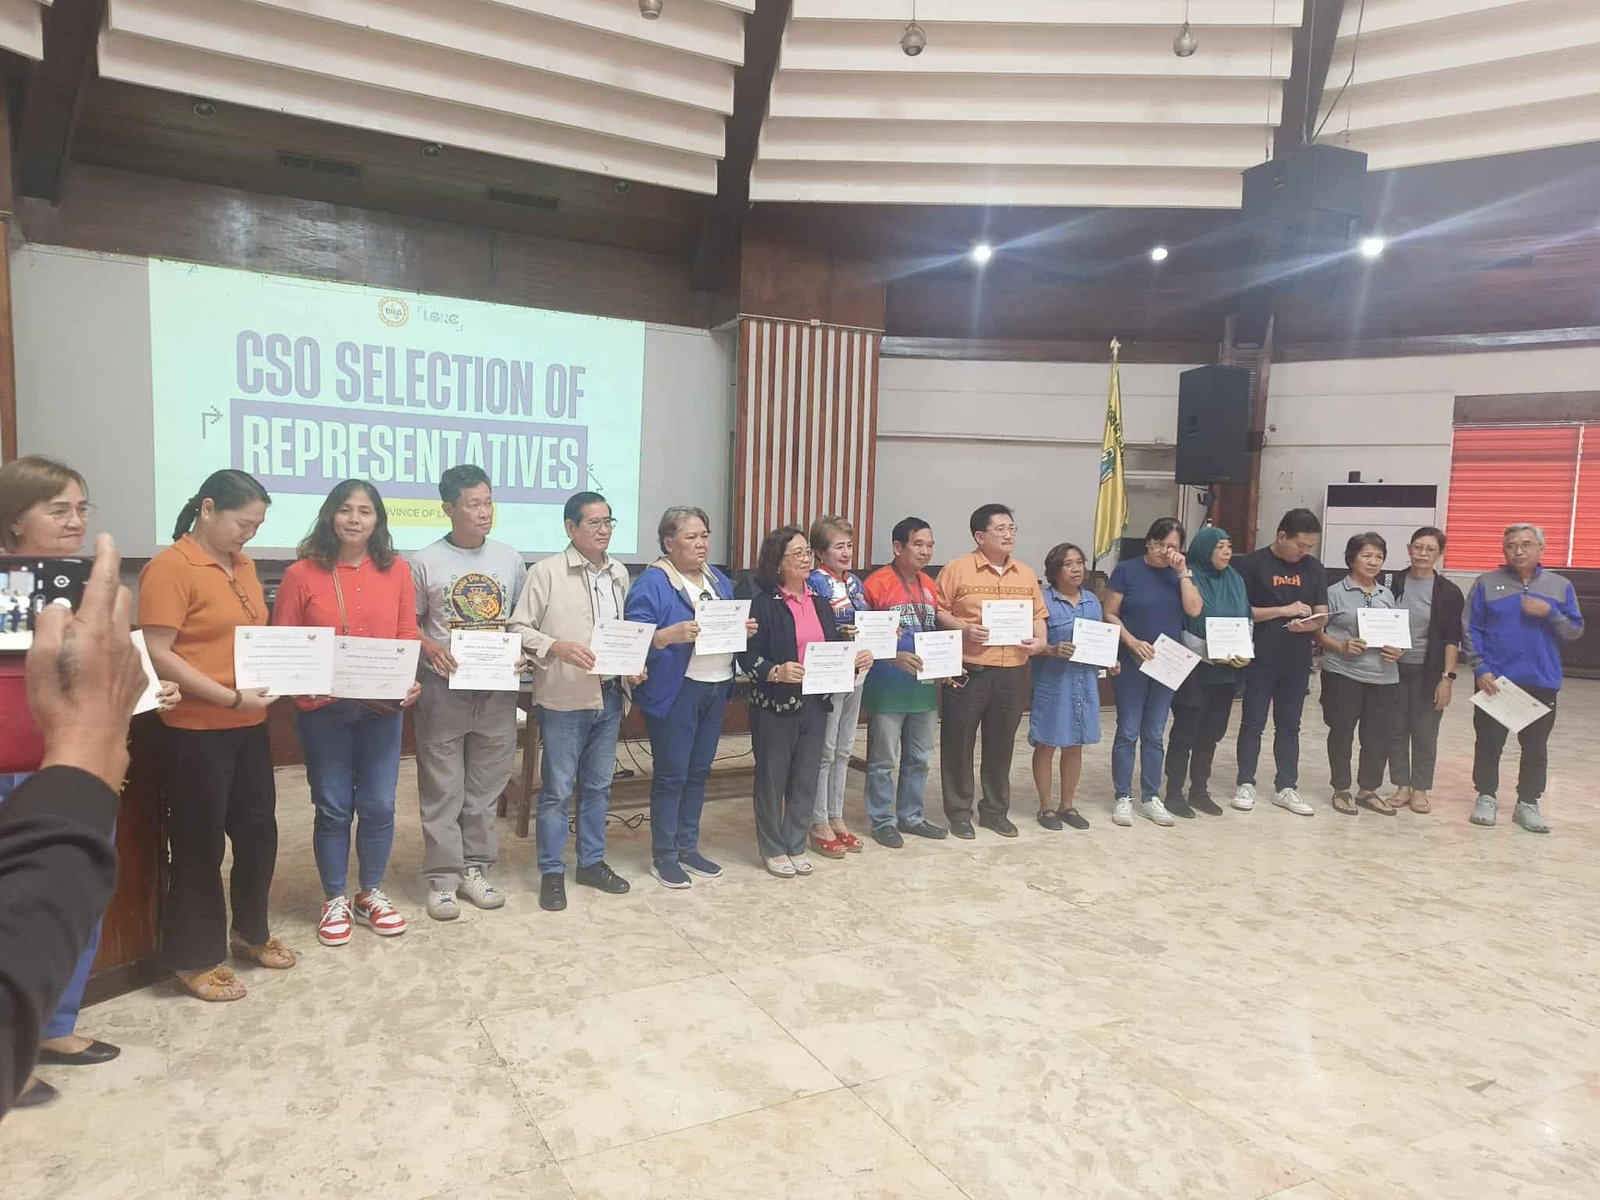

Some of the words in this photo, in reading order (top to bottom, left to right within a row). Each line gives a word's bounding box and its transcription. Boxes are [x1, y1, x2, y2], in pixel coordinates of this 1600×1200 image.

[236, 330, 321, 399] CSO
[335, 341, 534, 417] SELECTION
[545, 363, 586, 420] OF
[242, 414, 579, 491] REPRESENTATIVES
[421, 508, 436, 518] OF
